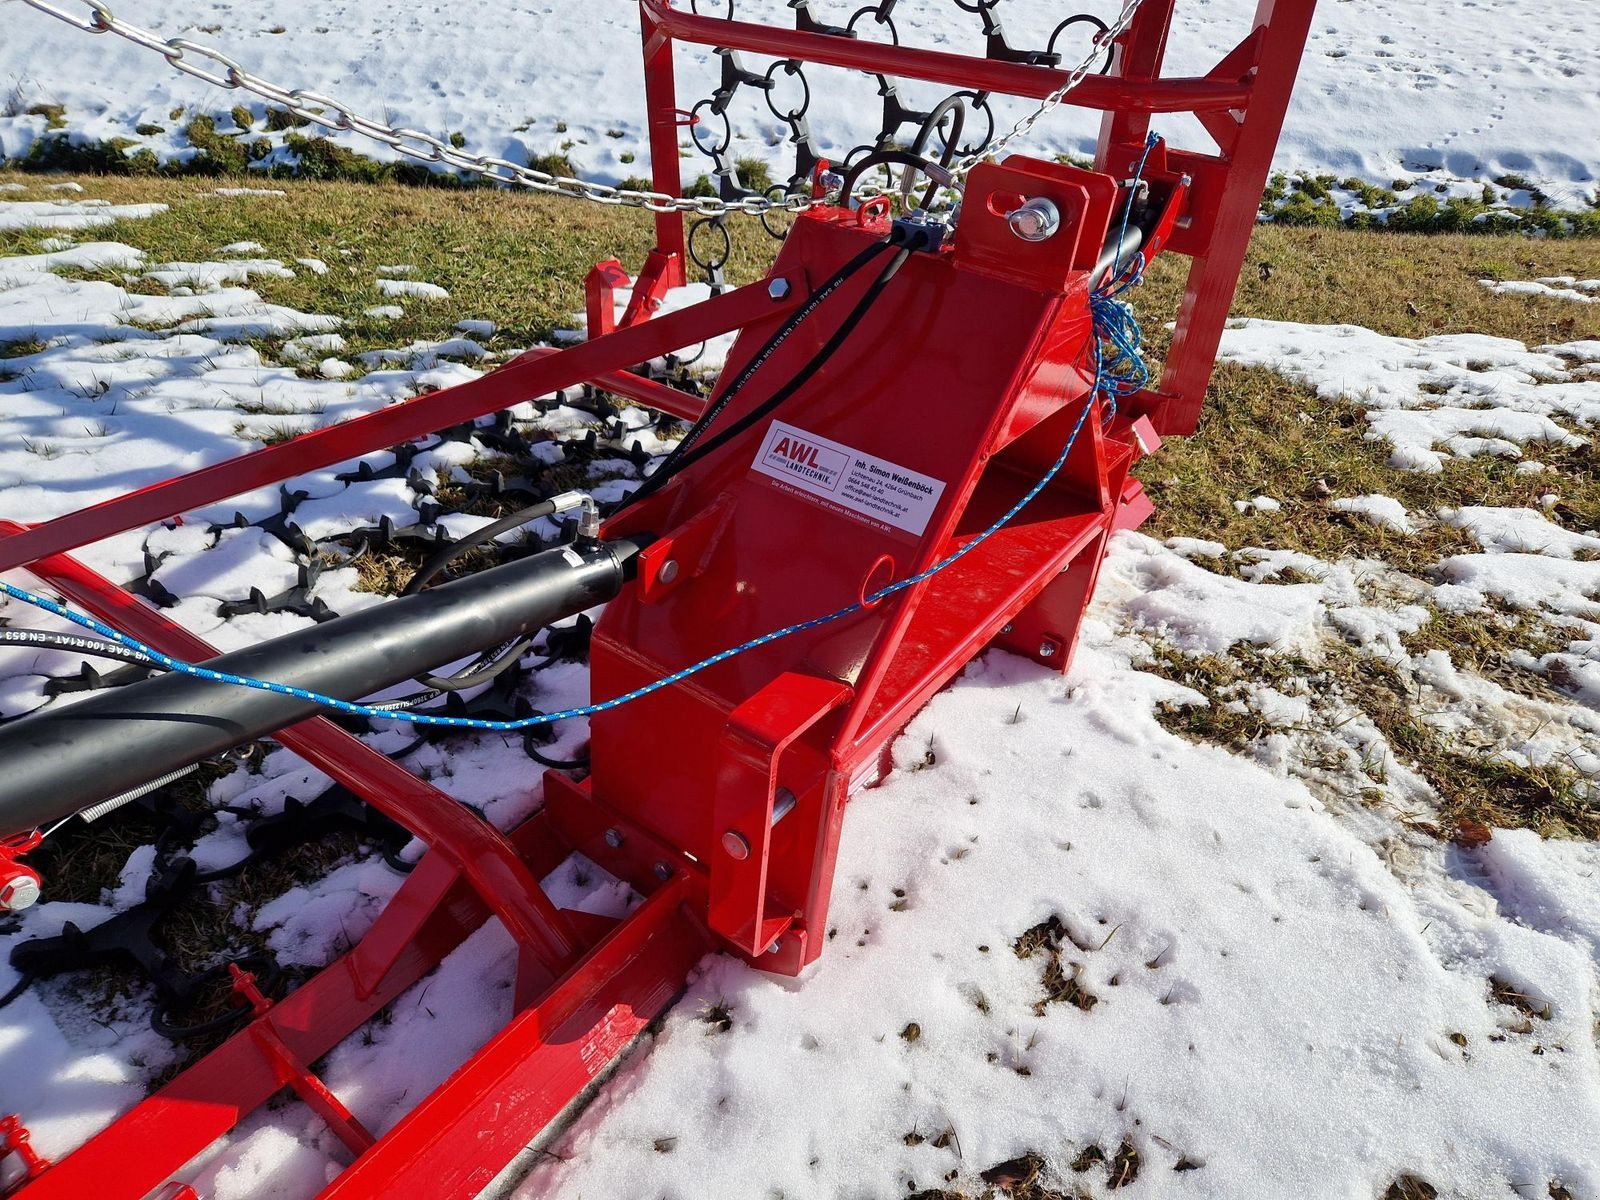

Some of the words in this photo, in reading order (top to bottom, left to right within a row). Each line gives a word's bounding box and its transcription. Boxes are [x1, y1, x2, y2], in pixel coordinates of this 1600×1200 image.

[773, 437, 819, 469] AWL
[851, 470, 876, 483] Lichtenau
[897, 487, 923, 502] Grünbach
[854, 459, 867, 470] Inh.
[868, 465, 891, 479] Simon
[891, 473, 934, 495] Weißenböck
[841, 491, 901, 519] www.awl-landtechnik.at
[844, 484, 909, 513] office@awl-landtechnik.at
[5, 631, 27, 641] 853
[30, 632, 46, 642] EN
[54, 636, 85, 648] R1AT
[87, 640, 106, 650] 100
[108, 644, 131, 657] SAE
